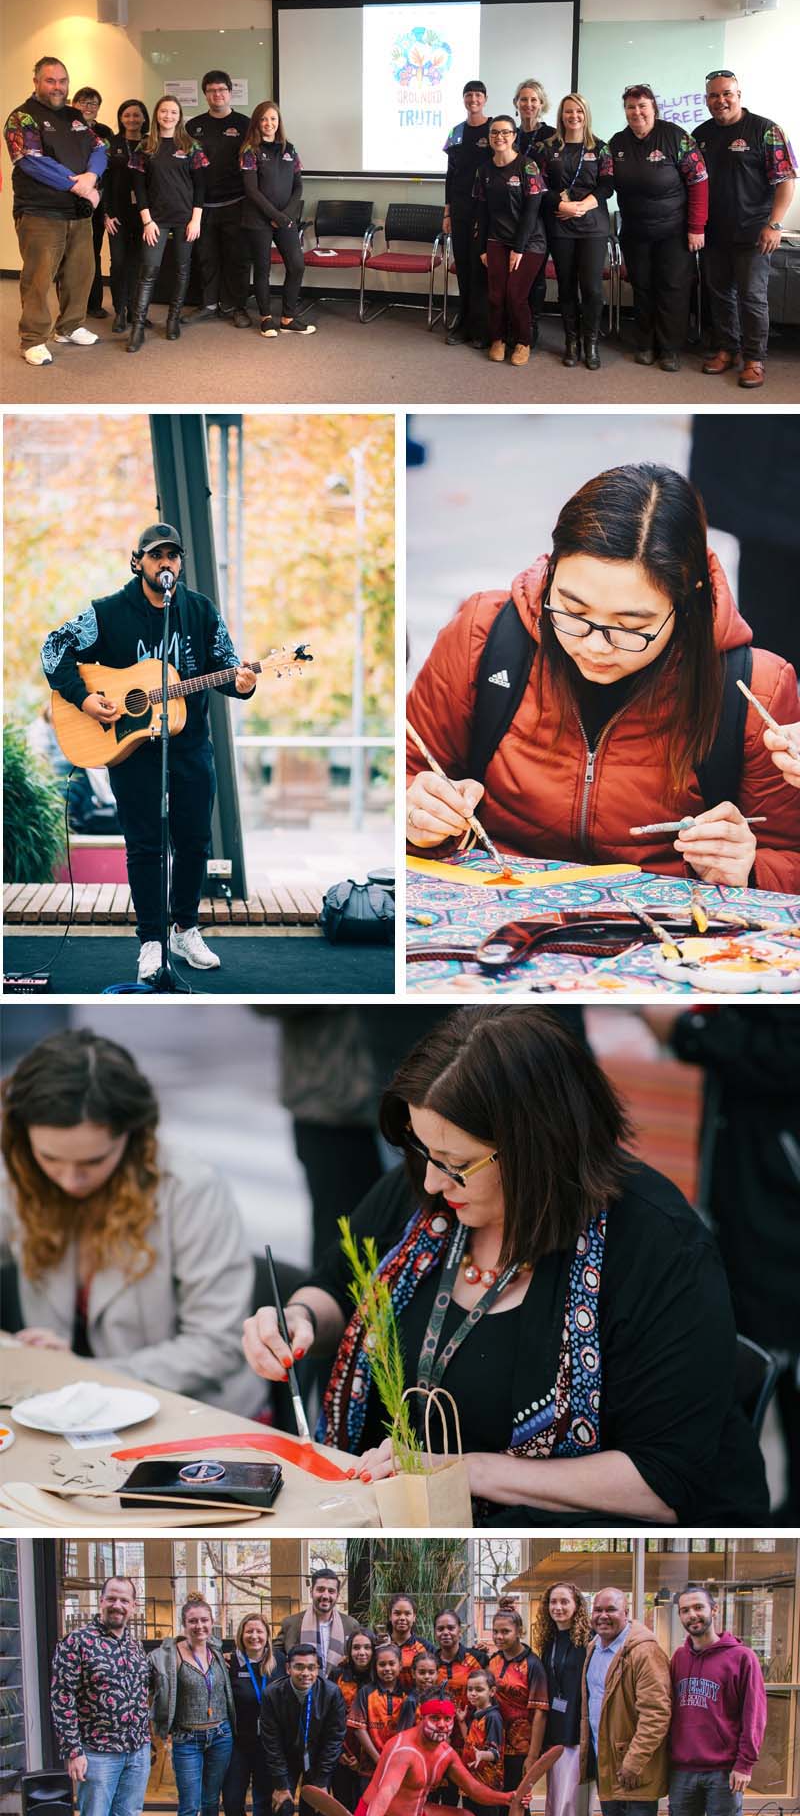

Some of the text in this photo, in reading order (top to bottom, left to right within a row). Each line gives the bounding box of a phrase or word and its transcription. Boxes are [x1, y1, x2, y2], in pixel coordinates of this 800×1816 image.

[397, 90, 442, 105] GROUNDED
[398, 110, 442, 127] TRUTH
[664, 109, 705, 123] FREE
